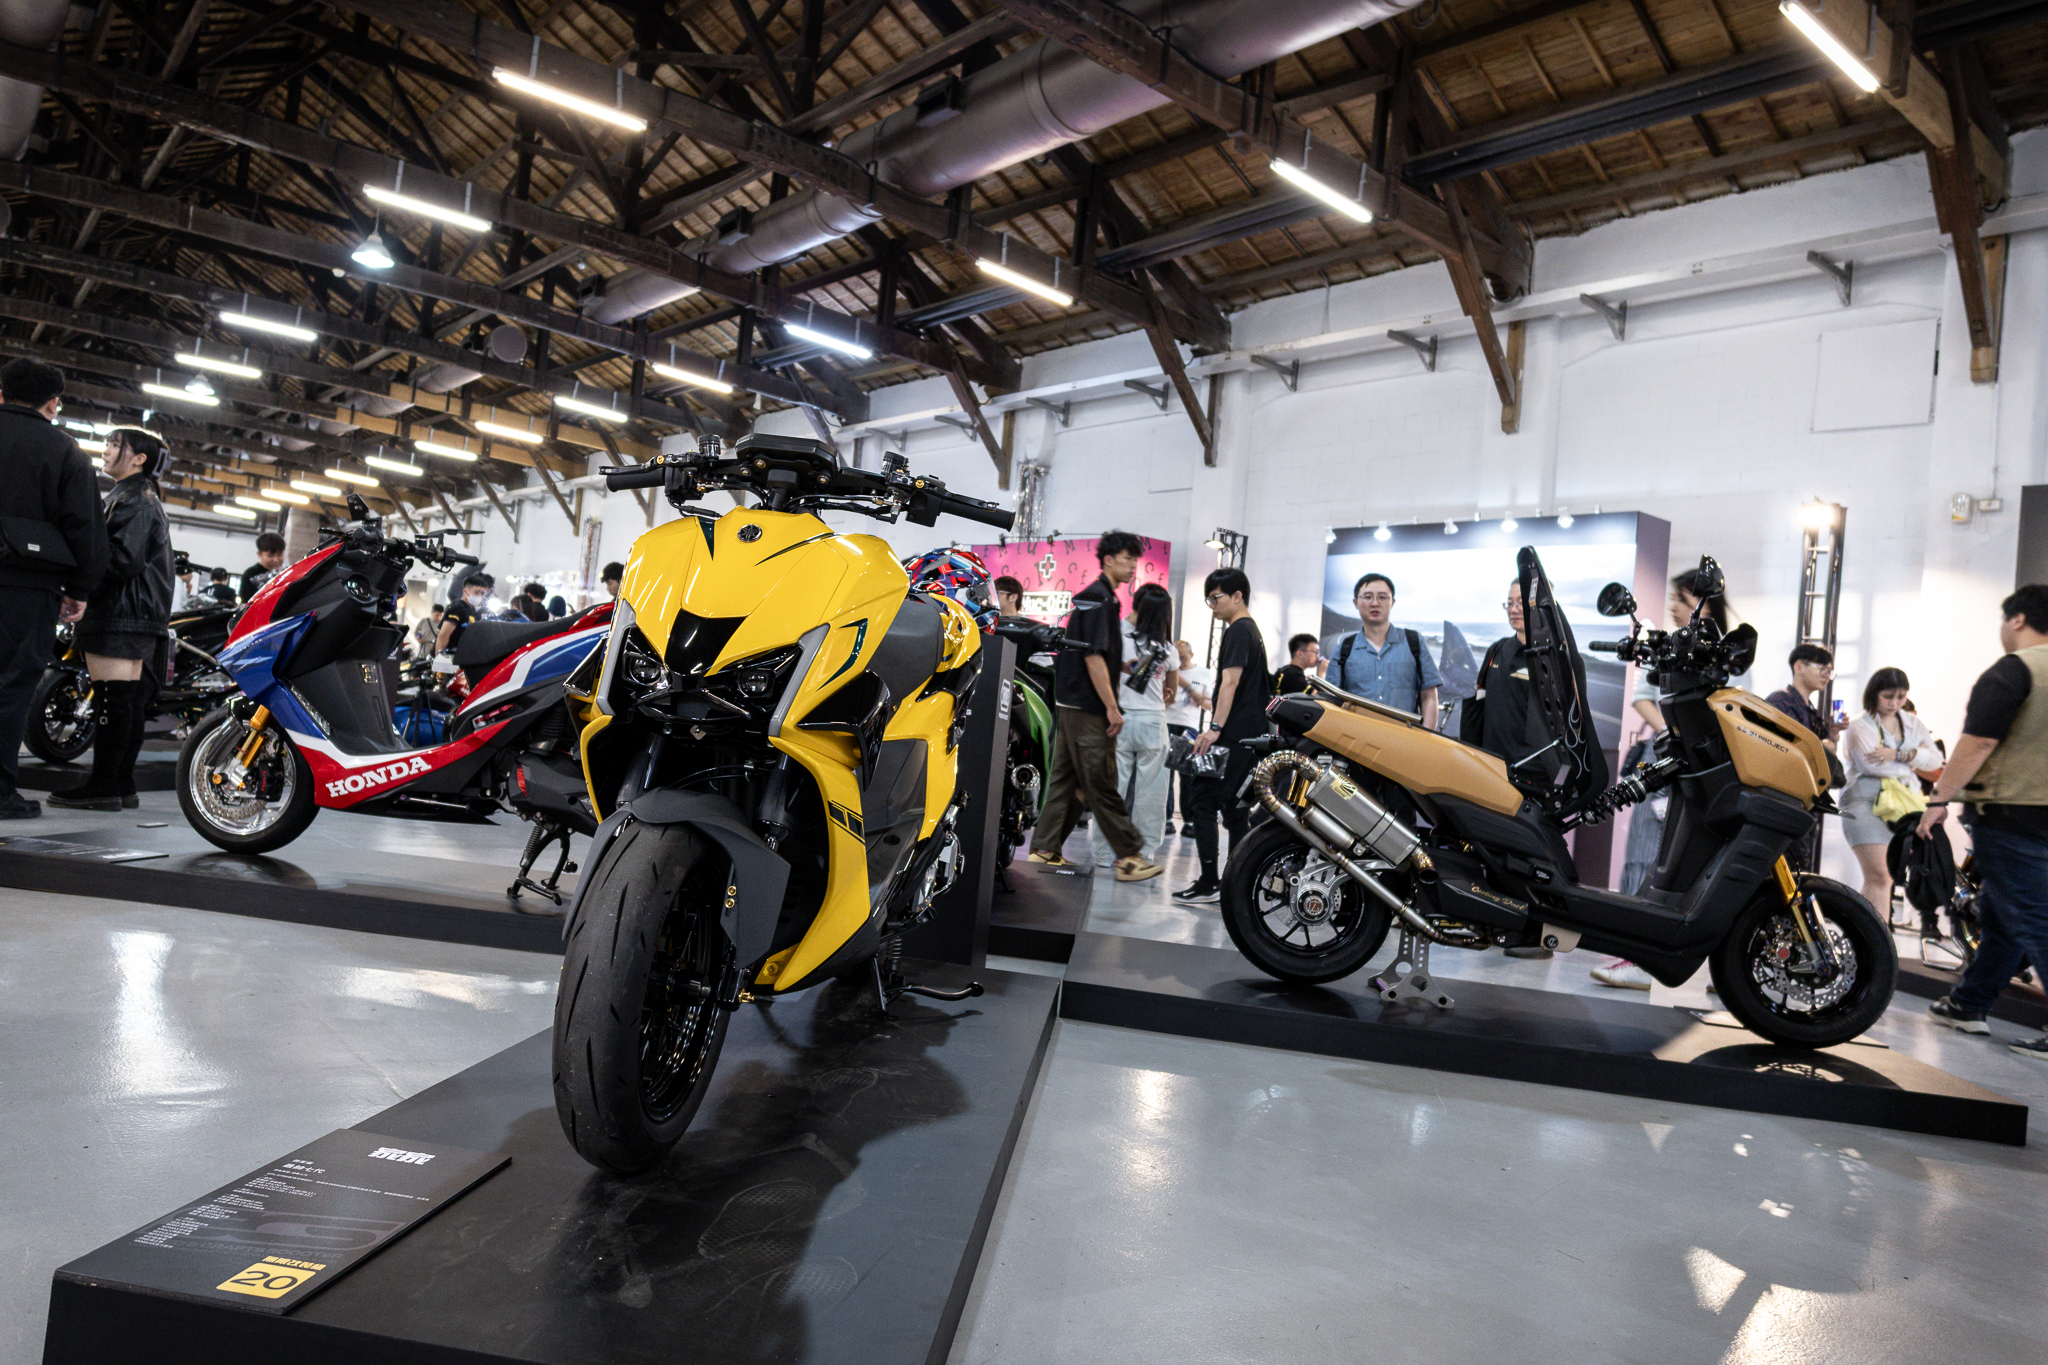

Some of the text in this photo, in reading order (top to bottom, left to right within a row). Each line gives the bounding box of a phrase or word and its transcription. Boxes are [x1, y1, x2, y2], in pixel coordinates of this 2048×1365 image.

[1022, 595, 1069, 613] Muc-Off
[325, 756, 432, 798] HONDA
[229, 1270, 298, 1290] 20
